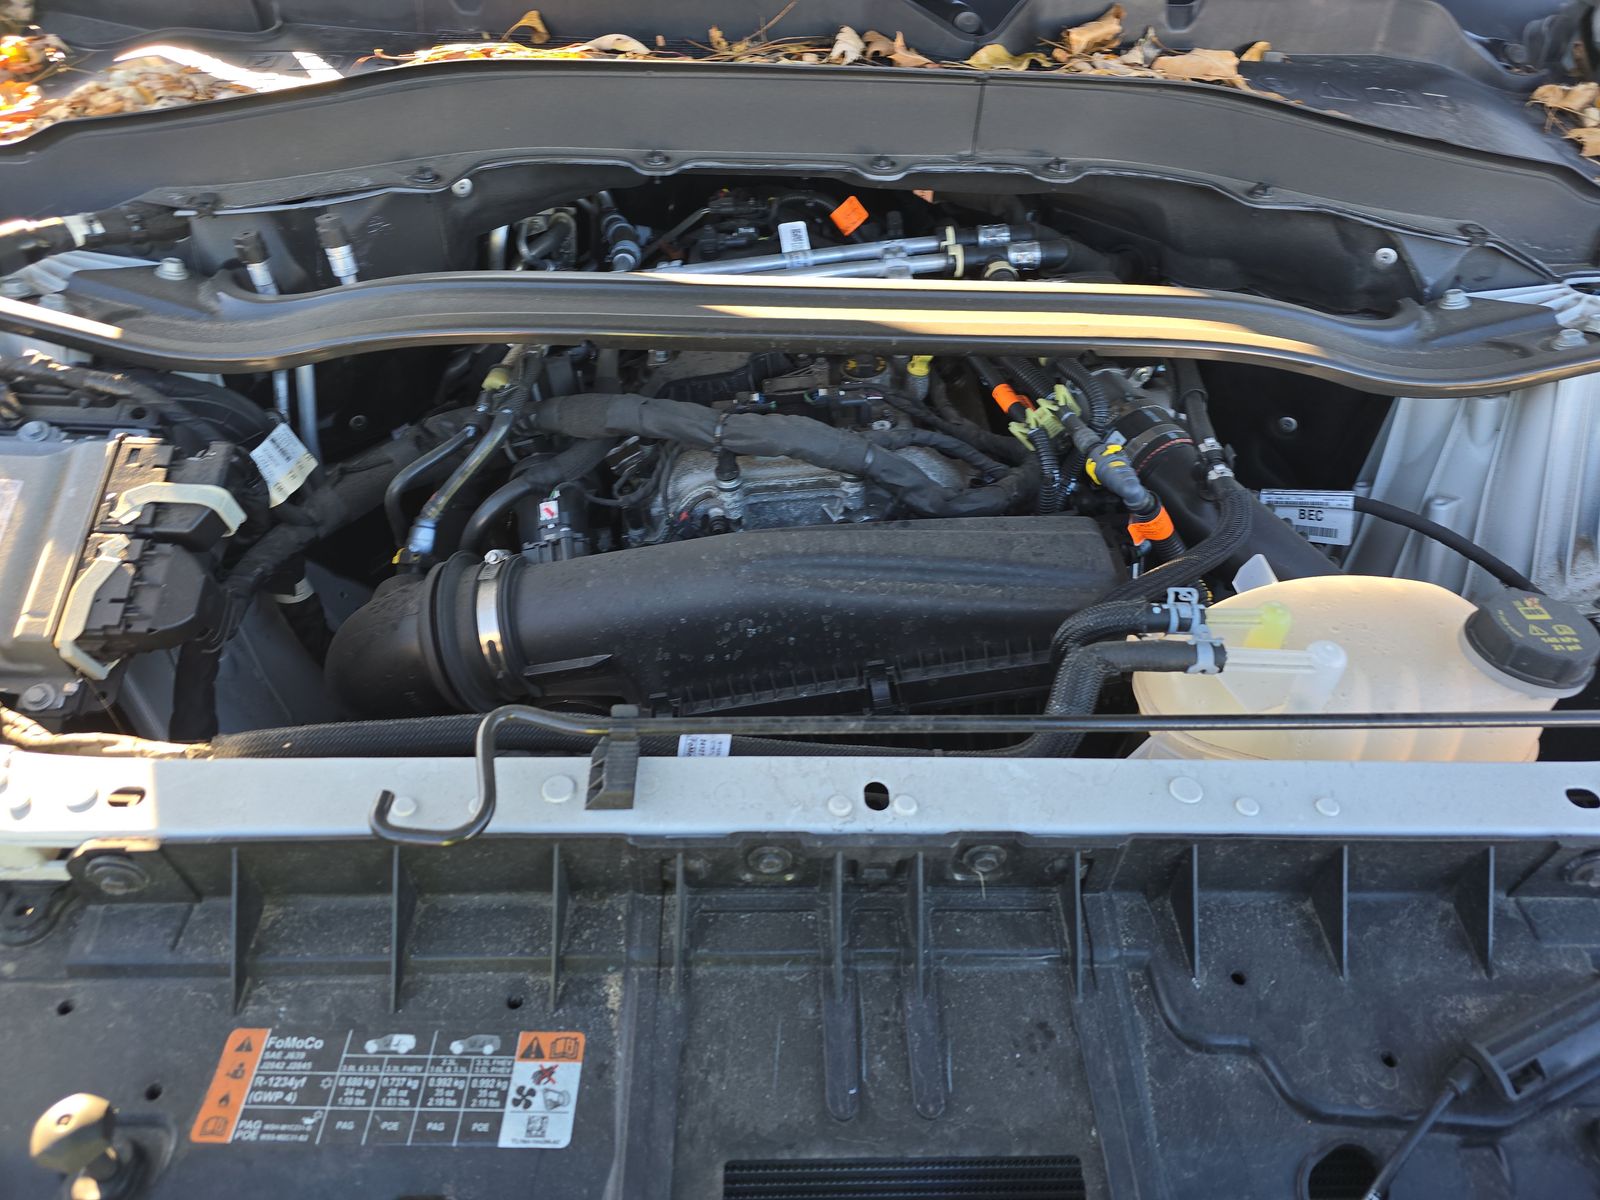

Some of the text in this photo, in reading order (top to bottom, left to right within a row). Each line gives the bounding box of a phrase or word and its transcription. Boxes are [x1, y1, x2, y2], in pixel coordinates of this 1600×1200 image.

[1298, 508, 1324, 522] BEC
[266, 1036, 325, 1050] FoMoCo
[263, 1051, 283, 1060] SAE
[253, 1076, 308, 1090] R-1234yf
[364, 1077, 376, 1089] kg
[382, 1077, 420, 1090] 0.737 kg
[453, 1078, 466, 1090] kg
[496, 1078, 509, 1091] kg
[248, 1091, 298, 1104] (GWP 4)
[355, 1089, 366, 1097] oz
[488, 1090, 498, 1098] oz
[237, 1120, 262, 1130] PAG
[335, 1120, 355, 1131] PAG
[380, 1121, 400, 1131] POE
[426, 1121, 445, 1132] PAG
[471, 1122, 490, 1132] POE
[235, 1130, 260, 1141] POE
